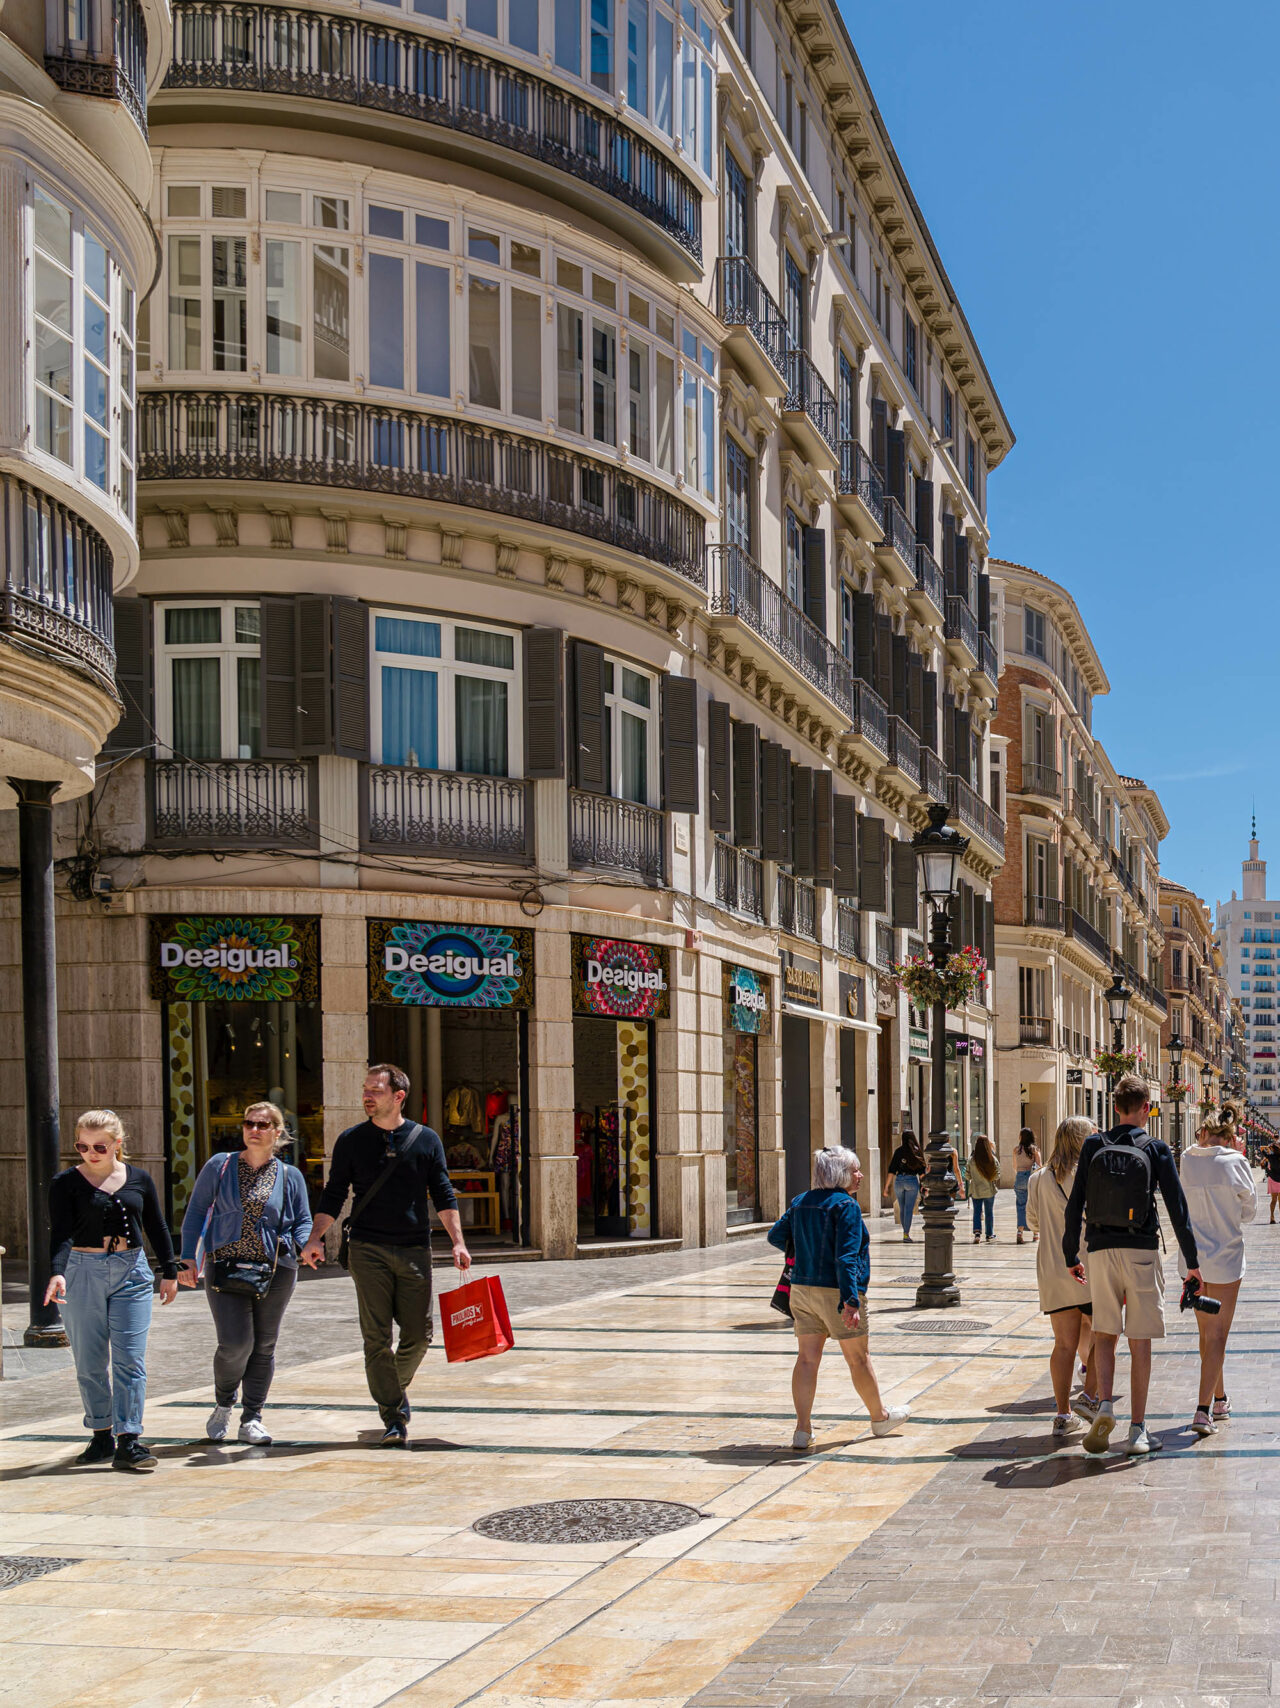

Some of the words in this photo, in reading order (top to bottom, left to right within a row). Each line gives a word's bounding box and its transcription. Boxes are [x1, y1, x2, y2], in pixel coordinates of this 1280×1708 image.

[161, 942, 289, 973] Desigual
[385, 946, 514, 980] Desigual
[588, 960, 663, 992] Desigual
